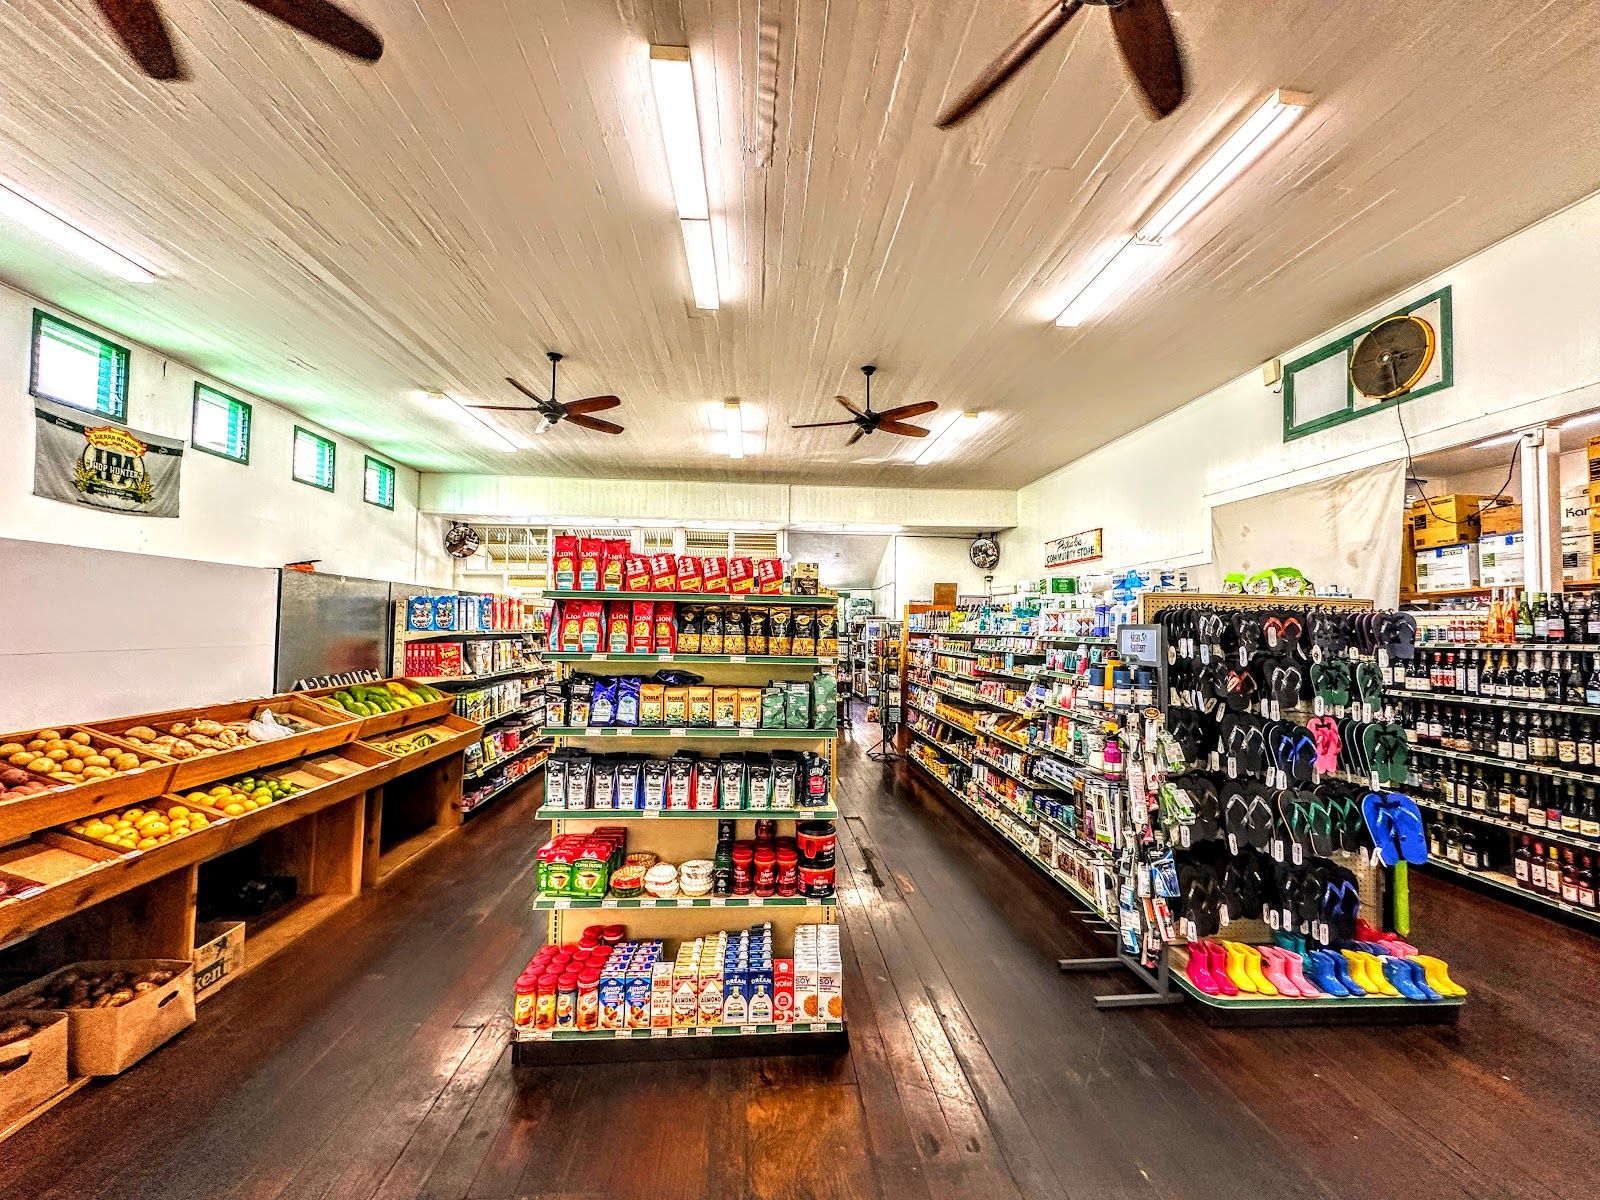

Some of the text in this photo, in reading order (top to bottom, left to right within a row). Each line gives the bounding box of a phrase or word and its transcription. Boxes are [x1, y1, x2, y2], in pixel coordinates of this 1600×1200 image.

[93, 432, 116, 441] SIERRA
[93, 461, 139, 479] HOP HUNTER
[94, 449, 137, 484] IPA
[1077, 545, 1095, 558] STORE
